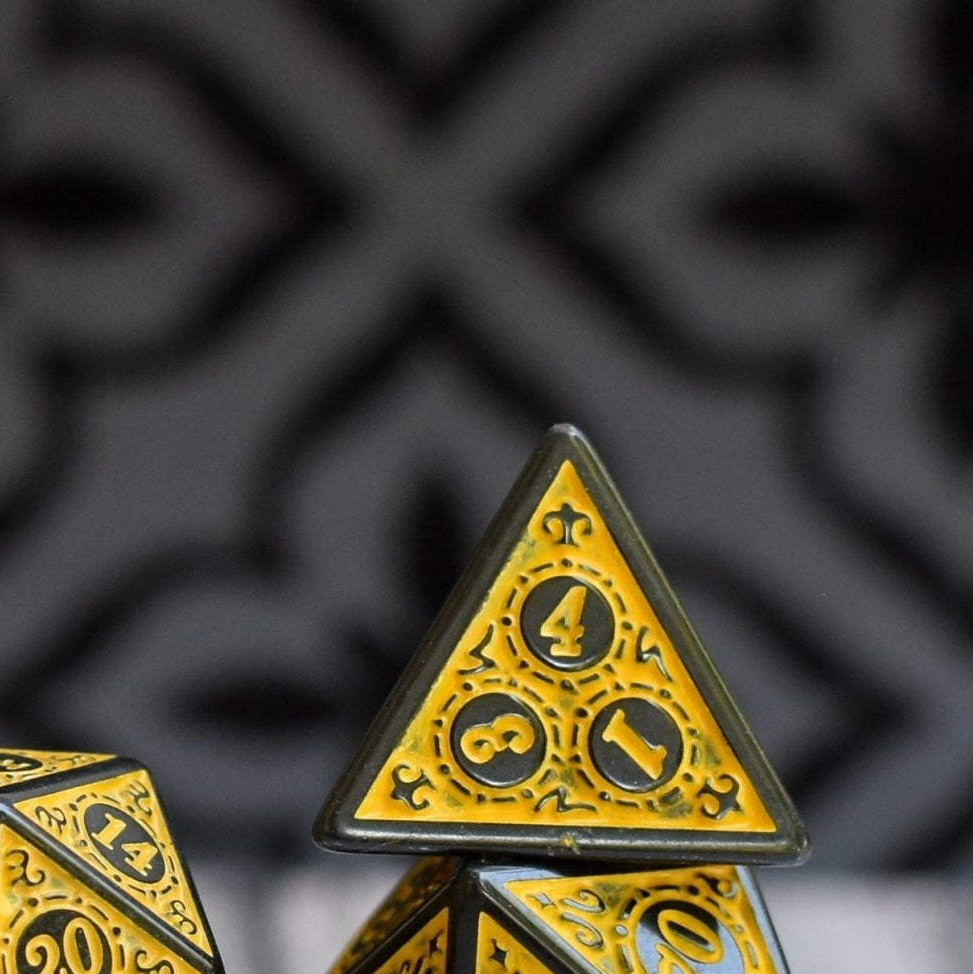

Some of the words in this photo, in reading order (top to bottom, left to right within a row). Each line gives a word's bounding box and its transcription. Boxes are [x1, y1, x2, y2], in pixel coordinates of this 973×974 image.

[538, 584, 588, 658] 4
[601, 708, 669, 781] 1
[91, 812, 158, 877] 14
